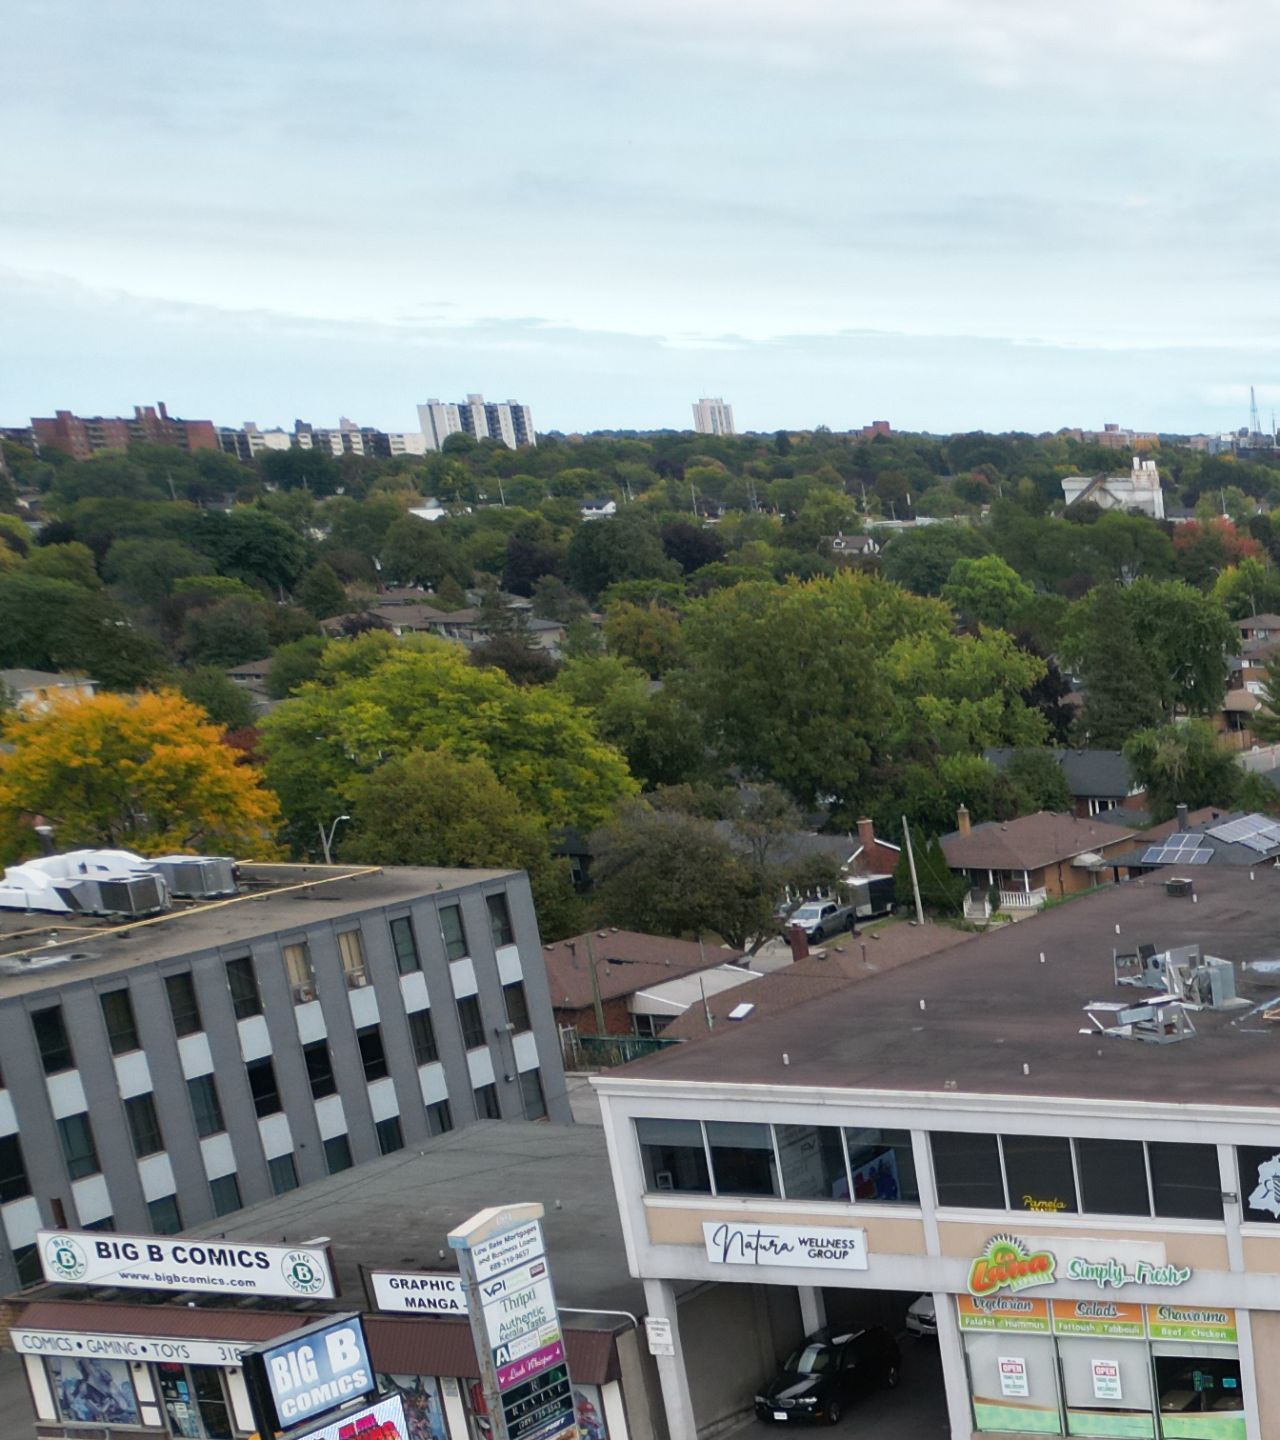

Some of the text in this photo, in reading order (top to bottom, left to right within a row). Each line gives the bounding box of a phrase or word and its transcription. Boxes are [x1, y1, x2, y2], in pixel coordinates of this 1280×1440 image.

[1022, 1195, 1067, 1210] Pamela
[52, 1239, 74, 1249] BIG
[712, 1224, 855, 1265] Natura WELLNESS
[95, 1241, 271, 1270] BIG B COMICS
[288, 1252, 311, 1264] BIG
[808, 1249, 850, 1261] GROUP
[119, 1270, 256, 1288] www.bigbcomics.com
[1136, 1261, 1179, 1286] Fresh
[389, 1278, 456, 1292] GRAPHIC
[483, 1279, 506, 1299] VPI
[405, 1296, 459, 1310] MANGA
[500, 1287, 537, 1314] Thripti
[972, 1297, 1033, 1312] Vegetarian
[1075, 1301, 1118, 1318] Salads
[1158, 1306, 1229, 1324] Shawarma
[499, 1305, 546, 1334] Authentic
[1004, 1319, 1045, 1330] Hummus
[1161, 1327, 1227, 1339] Beef Chicken
[21, 1335, 73, 1352] COMICS
[86, 1339, 138, 1356] GAMING
[150, 1343, 191, 1360] TOYS
[270, 1328, 361, 1396] BIG B
[1003, 1364, 1023, 1374] OPEN
[1095, 1366, 1117, 1376] OPEN
[281, 1368, 368, 1419] COMICS
